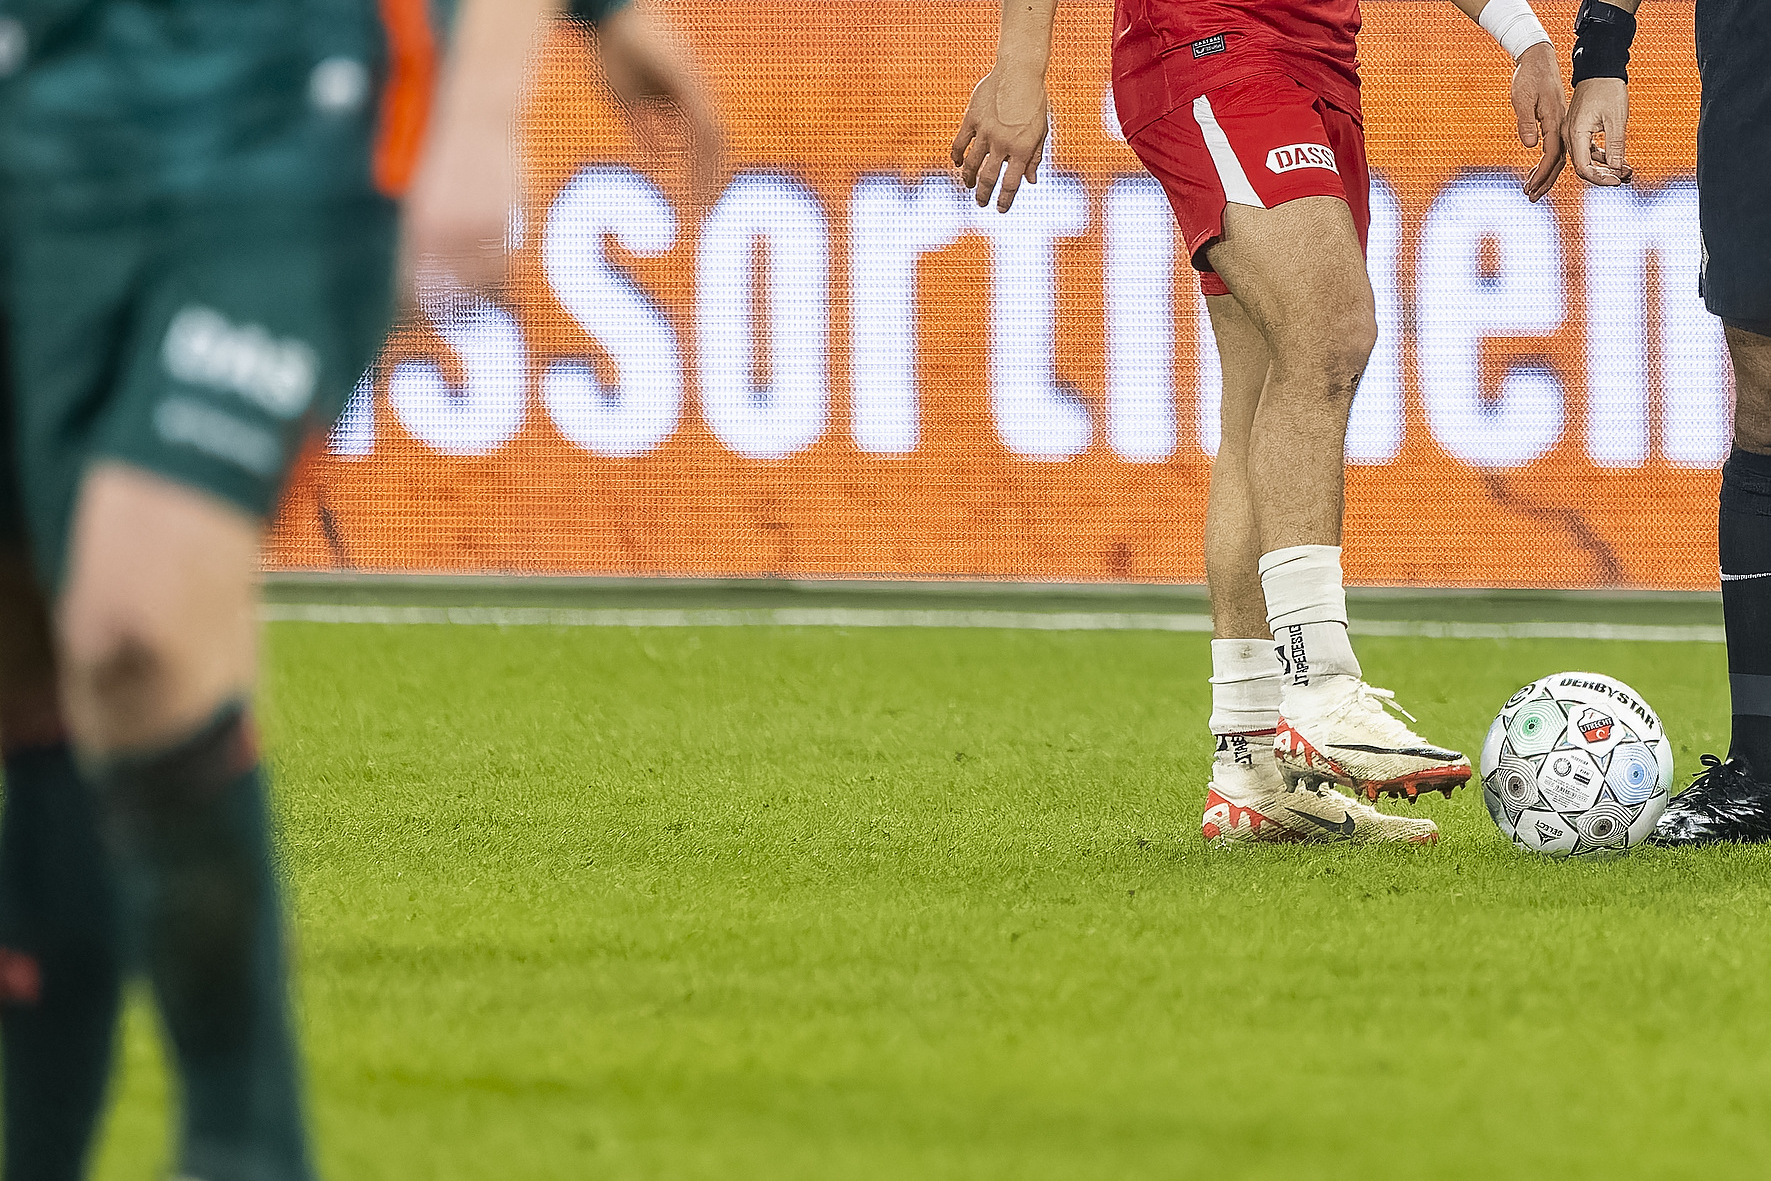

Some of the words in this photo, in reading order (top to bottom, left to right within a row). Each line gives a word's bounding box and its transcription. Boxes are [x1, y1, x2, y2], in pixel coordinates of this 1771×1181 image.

[1275, 147, 1334, 168] DASS
[1560, 678, 1655, 730] DERBYSTAR
[1581, 718, 1614, 733] UTRECHT
[1535, 819, 1564, 837] SELECT
